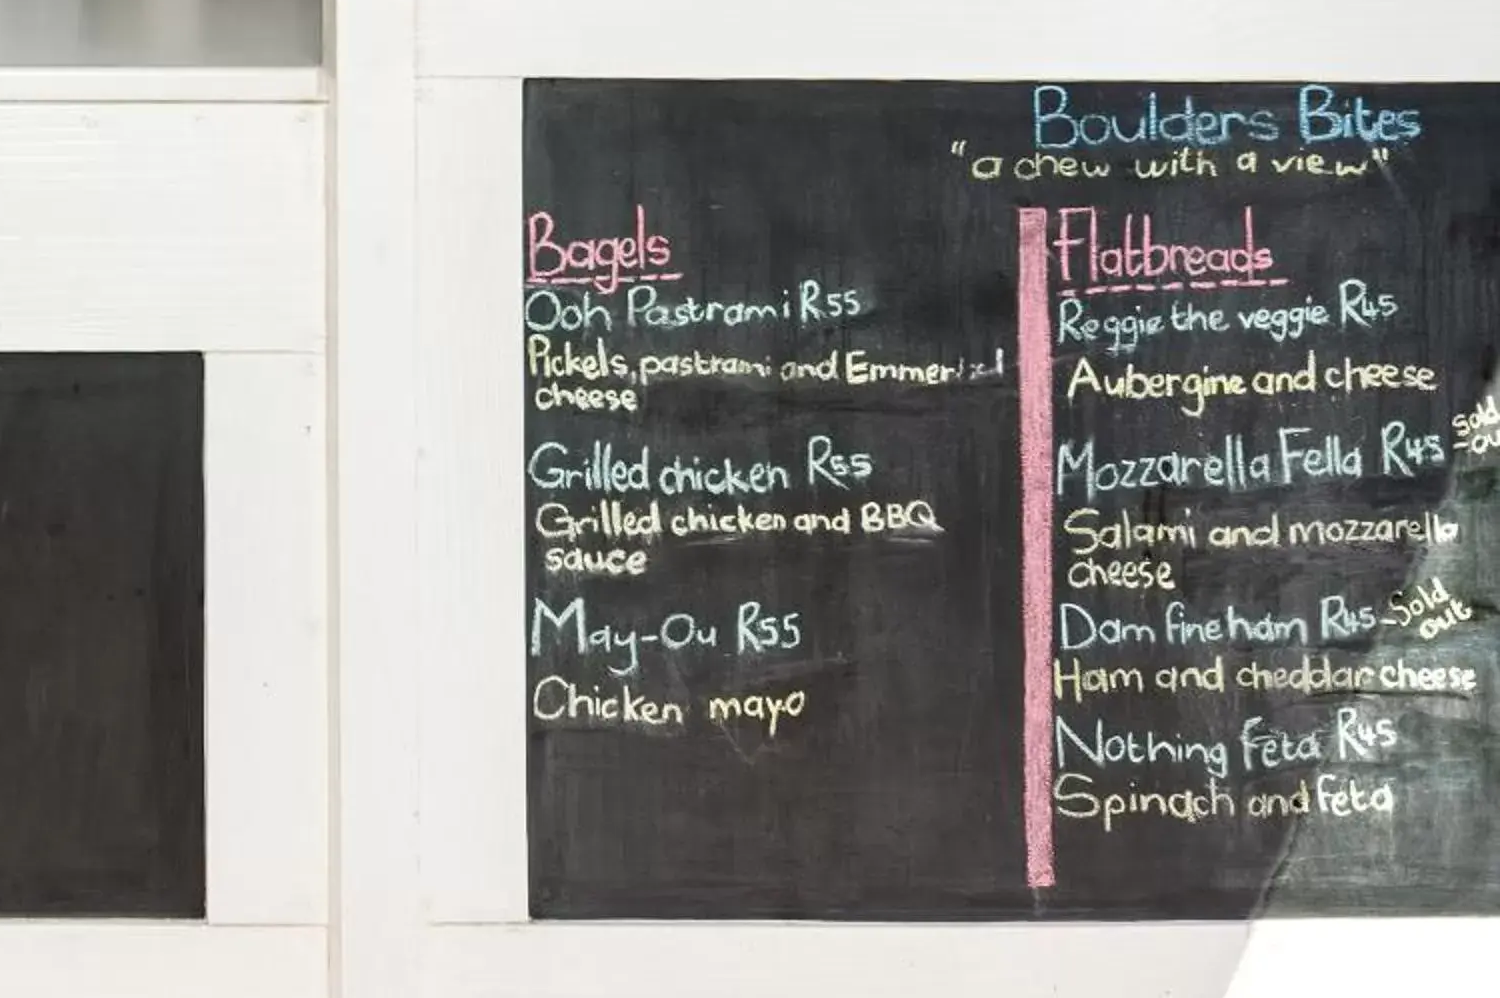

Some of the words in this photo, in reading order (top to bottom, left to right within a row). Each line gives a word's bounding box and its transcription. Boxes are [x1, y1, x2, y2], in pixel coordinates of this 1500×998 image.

[1034, 84, 1280, 149] Boulders
[1299, 84, 1422, 144] Bites
[1012, 150, 1110, 180] chew
[1134, 147, 1218, 179] with
[1236, 151, 1257, 175] a
[528, 204, 672, 294] Bagels
[1053, 205, 1274, 283] Flatbreads
[525, 288, 613, 332] Ooh
[626, 284, 791, 329] Pastrami
[800, 279, 861, 325] R55
[1057, 298, 1166, 356] Reggie
[1169, 302, 1229, 332] the
[1236, 295, 1330, 343] veggie
[1338, 278, 1399, 329] R45
[639, 352, 772, 386] pastrami
[780, 349, 838, 382] and
[1067, 356, 1247, 418] Aubergine
[1251, 349, 1317, 396] and
[1323, 356, 1440, 394] cheese
[534, 381, 639, 413] cheese
[527, 440, 652, 492] Grilled
[658, 455, 791, 496] chicken
[807, 434, 875, 492] R55
[1056, 434, 1270, 500] Mozzarella
[1278, 426, 1363, 485] Fella
[1380, 421, 1446, 478] R45
[535, 498, 663, 542] Grilled
[670, 503, 787, 537] chicken
[793, 506, 852, 535] and
[860, 499, 947, 535] BBQ
[1062, 507, 1197, 555] Salami
[1208, 511, 1280, 548] and
[1289, 510, 1460, 549] mozzarella
[545, 547, 649, 575] sauce
[1067, 557, 1177, 590] cheese
[531, 597, 718, 676] May-Ou
[736, 601, 800, 655] R55
[1060, 602, 1156, 650] Dam
[1164, 600, 1224, 645] fine
[1227, 604, 1308, 646] ham
[1320, 594, 1376, 640] R45
[1418, 599, 1473, 641] out
[533, 675, 684, 726] Chicken
[708, 690, 806, 737] mayo
[1053, 655, 1143, 703] Ham
[1155, 654, 1225, 692] and
[1236, 653, 1375, 695] cheddar
[1379, 658, 1477, 691] cheese
[1055, 714, 1230, 778] Nothing
[1336, 707, 1398, 761] R45
[1053, 772, 1236, 832] Spinach
[1247, 779, 1310, 819] and
